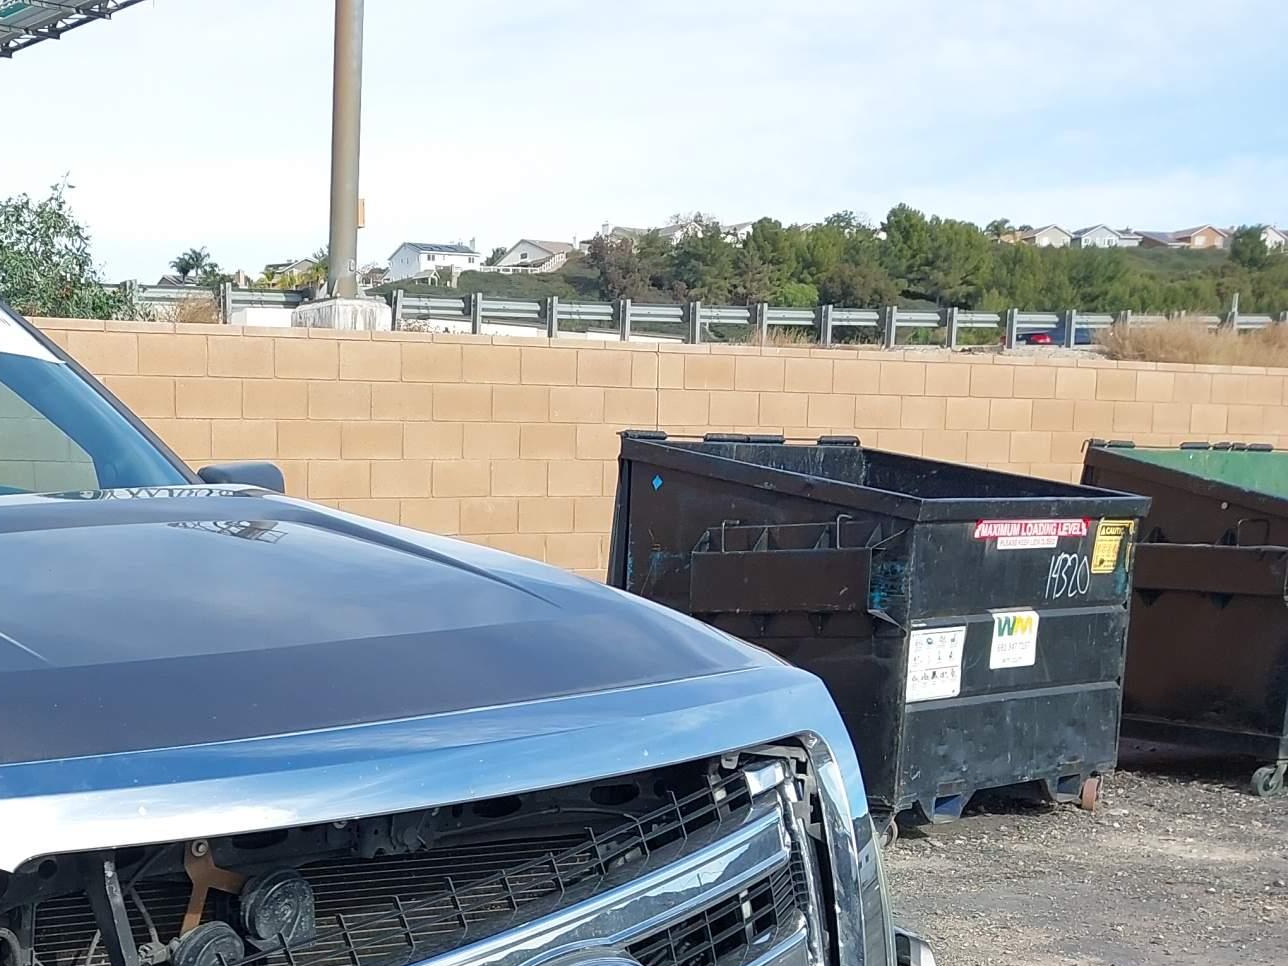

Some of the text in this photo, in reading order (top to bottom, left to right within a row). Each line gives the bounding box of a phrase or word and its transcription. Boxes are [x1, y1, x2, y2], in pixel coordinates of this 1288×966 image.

[980, 522, 1082, 537] MAXIMUM LOADING LEVEL
[1045, 552, 1090, 600] 14320
[997, 615, 1033, 637] WM
